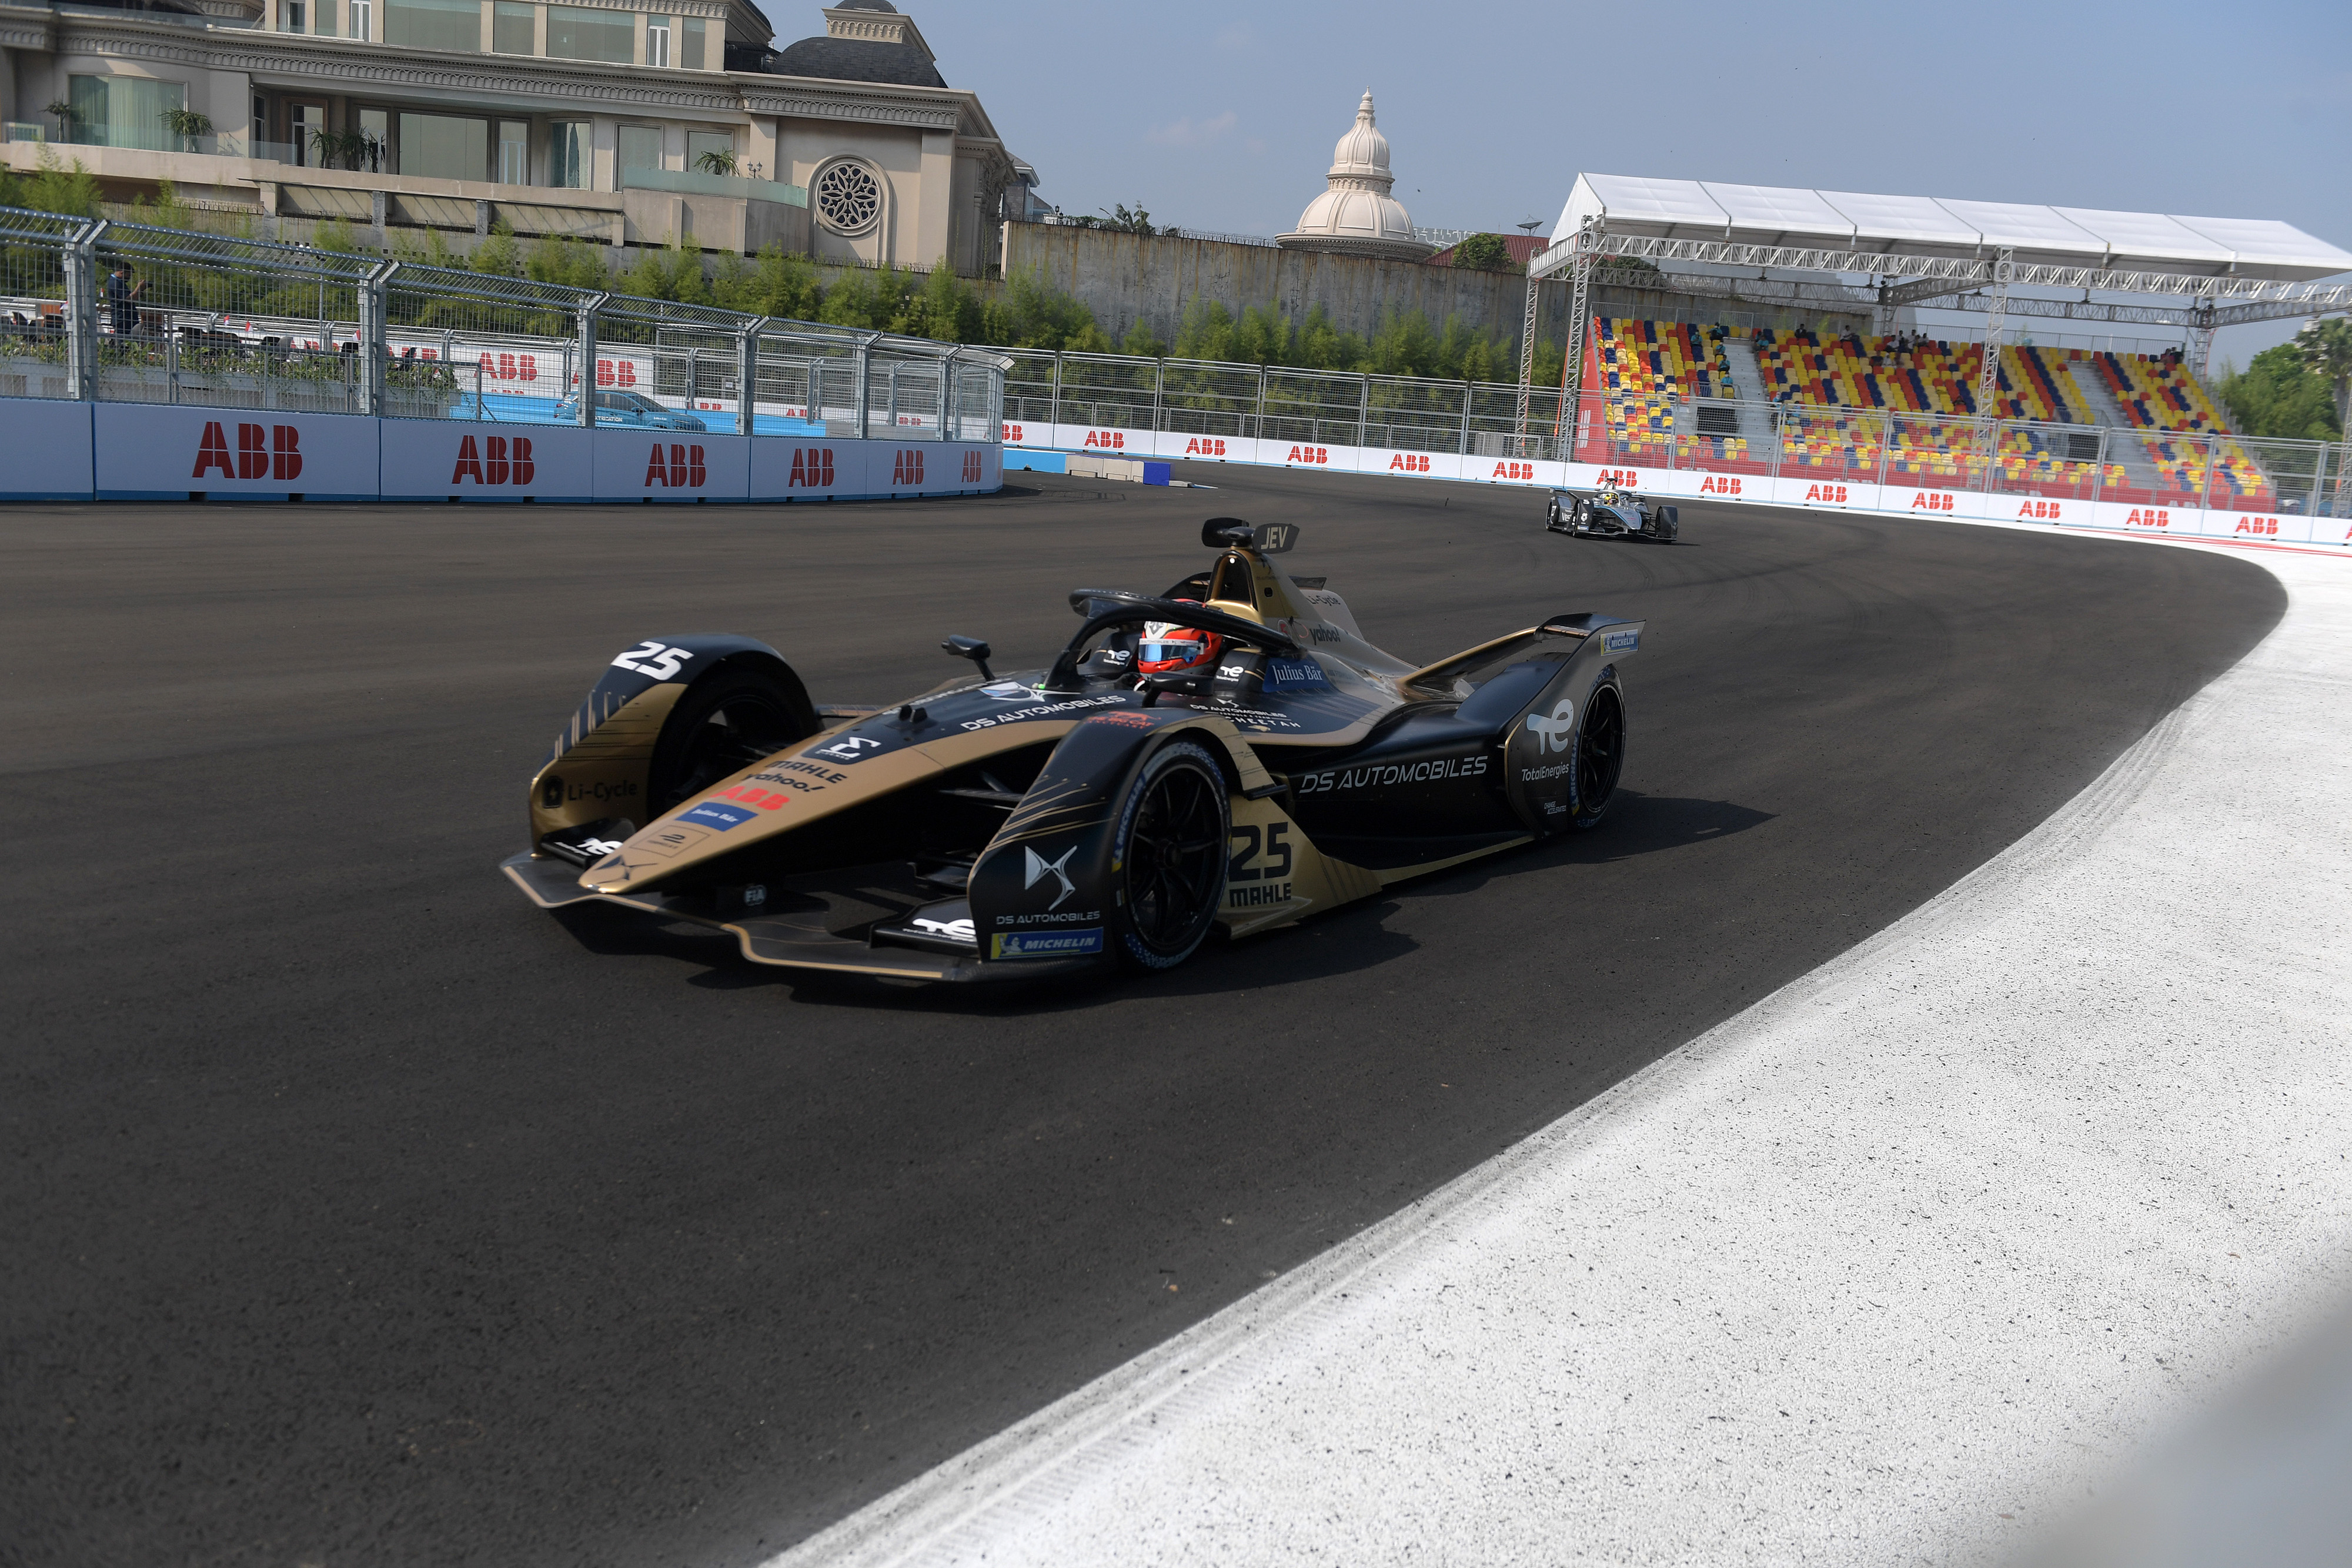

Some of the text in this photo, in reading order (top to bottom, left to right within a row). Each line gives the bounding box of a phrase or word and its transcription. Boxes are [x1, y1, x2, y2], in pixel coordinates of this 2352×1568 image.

[474, 352, 537, 381] ABB
[572, 360, 636, 387] BB
[1002, 424, 1023, 441] BB
[1085, 431, 1124, 449] ABB
[193, 422, 302, 480] ABB
[1187, 438, 1226, 456] ABB
[1288, 446, 1328, 464] ABB
[453, 436, 534, 485] ABB
[646, 444, 706, 487] ABB
[789, 449, 834, 487] ABB
[893, 450, 924, 485] ABB
[962, 450, 981, 483] ABB
[1390, 454, 1430, 472] ABB
[1493, 462, 1533, 480] ABB
[1596, 469, 1638, 487] ABB
[1700, 476, 1742, 494] ABB
[1806, 484, 1847, 502] ABB
[1912, 492, 1954, 510] ABB
[2019, 500, 2061, 519] ABB
[2127, 509, 2169, 527] ABB
[2236, 516, 2278, 534] ABB
[1261, 526, 1288, 550] JEV
[1307, 595, 1341, 606] Li-Cycle
[1309, 624, 1341, 646] yahoo!
[1611, 637, 1635, 647] MICHELIN
[610, 641, 694, 681] 25
[1272, 665, 1304, 684] Julius
[1304, 665, 1322, 681] Bär
[960, 717, 996, 731] DS
[997, 695, 1127, 724] AUTOMOBILES
[1210, 706, 1287, 718] AUTOMOBILES
[766, 760, 848, 784] MAHLE
[1299, 755, 1488, 794] DS AUTOMOBILES
[1522, 762, 1569, 781] TotalEnergies
[568, 780, 637, 801] Li-Cycle
[741, 773, 826, 793] yahoo!
[709, 785, 790, 811] ABB
[1228, 821, 1292, 882] 25
[1229, 882, 1292, 907] MAHLE
[996, 911, 1100, 925] DS AUTOMOBILES
[1024, 937, 1095, 950] MICHELIN
